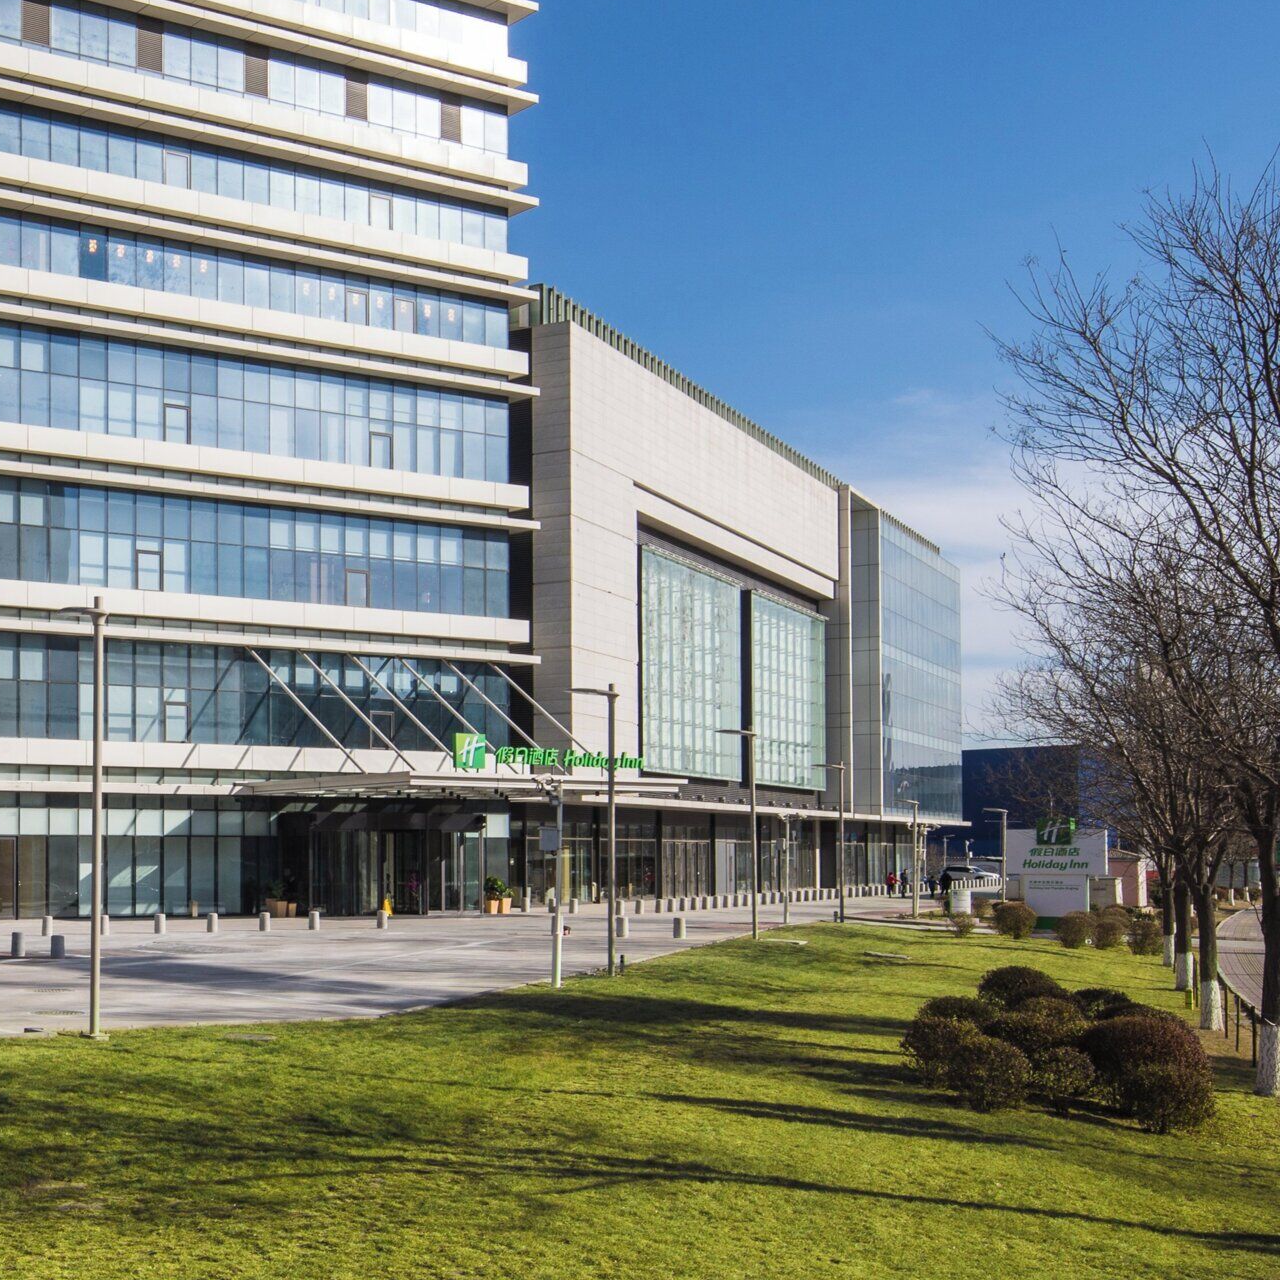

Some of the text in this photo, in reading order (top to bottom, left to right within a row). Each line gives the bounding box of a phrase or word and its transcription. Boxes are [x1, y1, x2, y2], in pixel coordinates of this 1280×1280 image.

[495, 746, 559, 766] 假日酒店
[620, 751, 644, 769] Inn
[1029, 847, 1080, 856] 假日酒店
[1023, 859, 1089, 871] Holiday Inn
